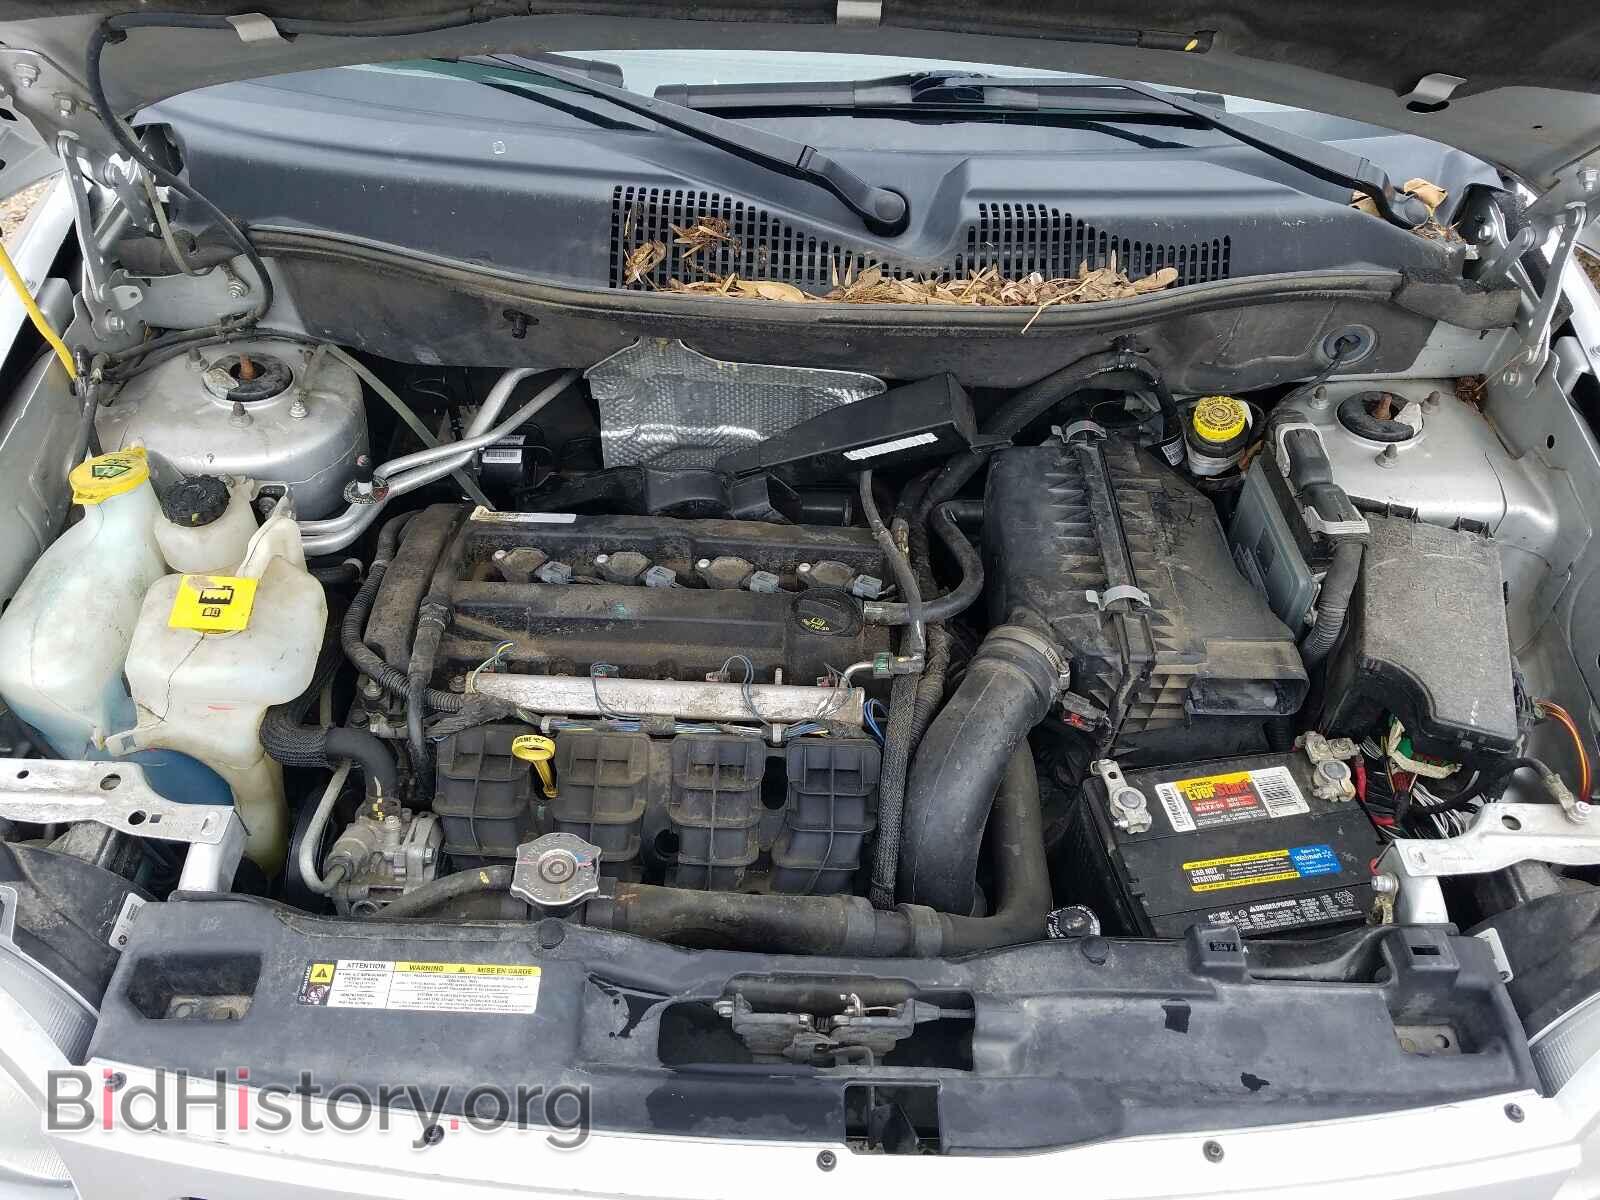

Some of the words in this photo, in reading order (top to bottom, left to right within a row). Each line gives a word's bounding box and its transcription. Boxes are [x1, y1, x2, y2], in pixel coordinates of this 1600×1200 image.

[1294, 853, 1323, 861] Walmart
[1191, 868, 1205, 877] CAR
[1205, 867, 1218, 875] NOT
[1192, 873, 1226, 884] STARTING?
[345, 962, 386, 970] ATTENTION
[409, 964, 444, 972] WARNING
[496, 967, 507, 975] EN
[508, 968, 533, 976] GARDE
